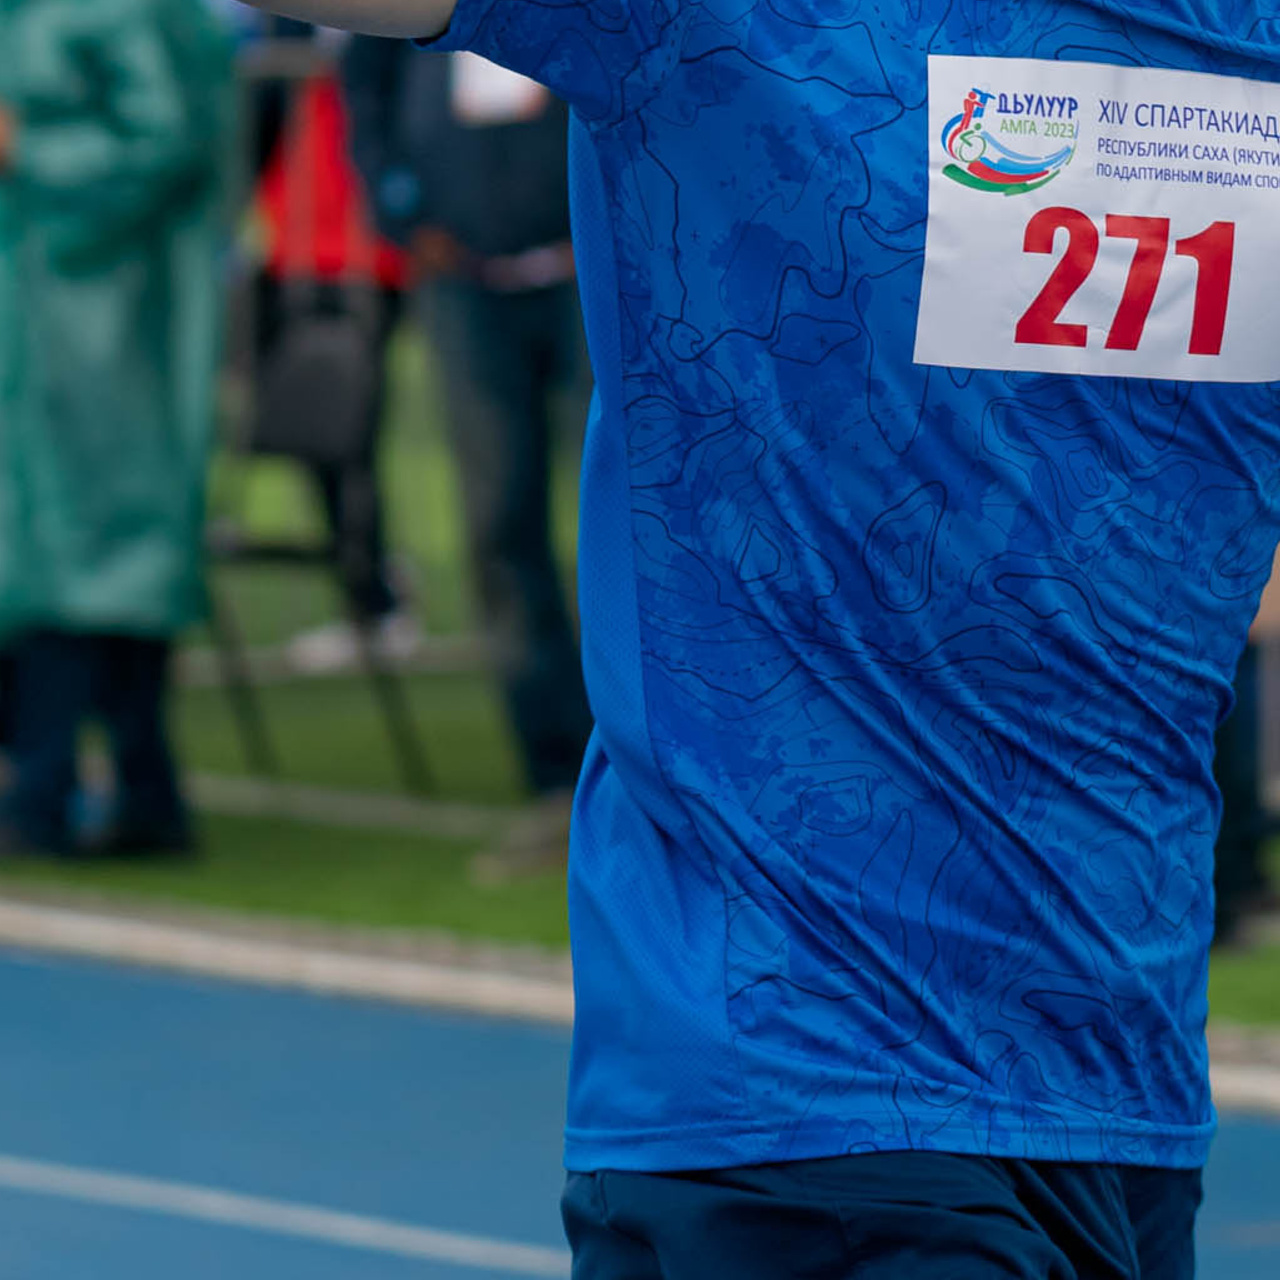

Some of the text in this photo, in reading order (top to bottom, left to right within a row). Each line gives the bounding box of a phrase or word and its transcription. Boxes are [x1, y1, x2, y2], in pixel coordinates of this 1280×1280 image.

[1098, 100, 1128, 125] XIV
[1000, 119, 1075, 138] АМГА 2023
[1098, 137, 1189, 159] РЕСПУБЛИКИ
[1193, 145, 1230, 161] САХА
[1206, 171, 1252, 188] ВИДАМ
[1013, 207, 1236, 356] 271
